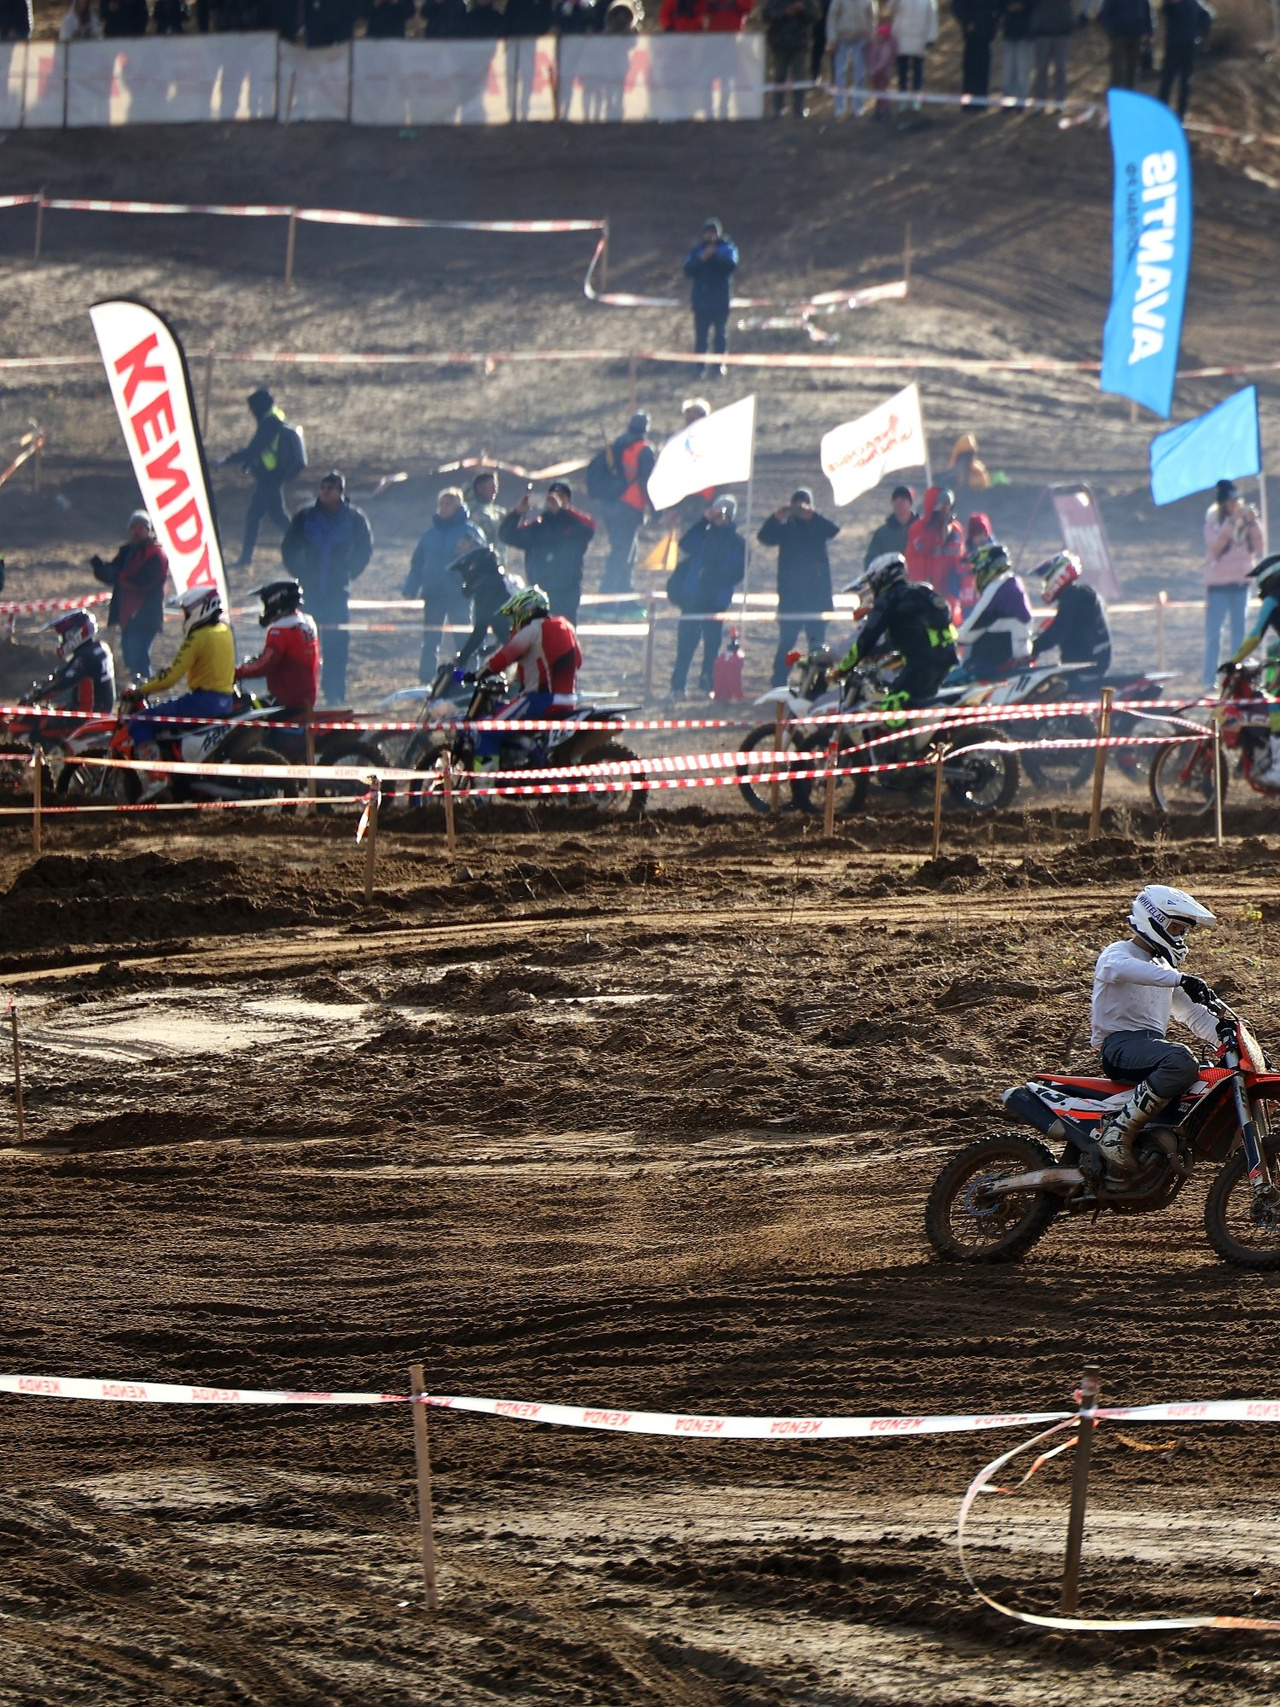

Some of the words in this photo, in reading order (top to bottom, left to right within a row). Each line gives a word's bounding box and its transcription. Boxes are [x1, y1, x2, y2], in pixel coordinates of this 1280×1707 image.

[1138, 895, 1166, 924] WHITELAB
[494, 1401, 542, 1417] KENDA
[583, 1410, 632, 1426] KENDA
[674, 1418, 725, 1433] KENDA
[869, 1417, 927, 1431] KENDA
[769, 1420, 823, 1434] KENDA
